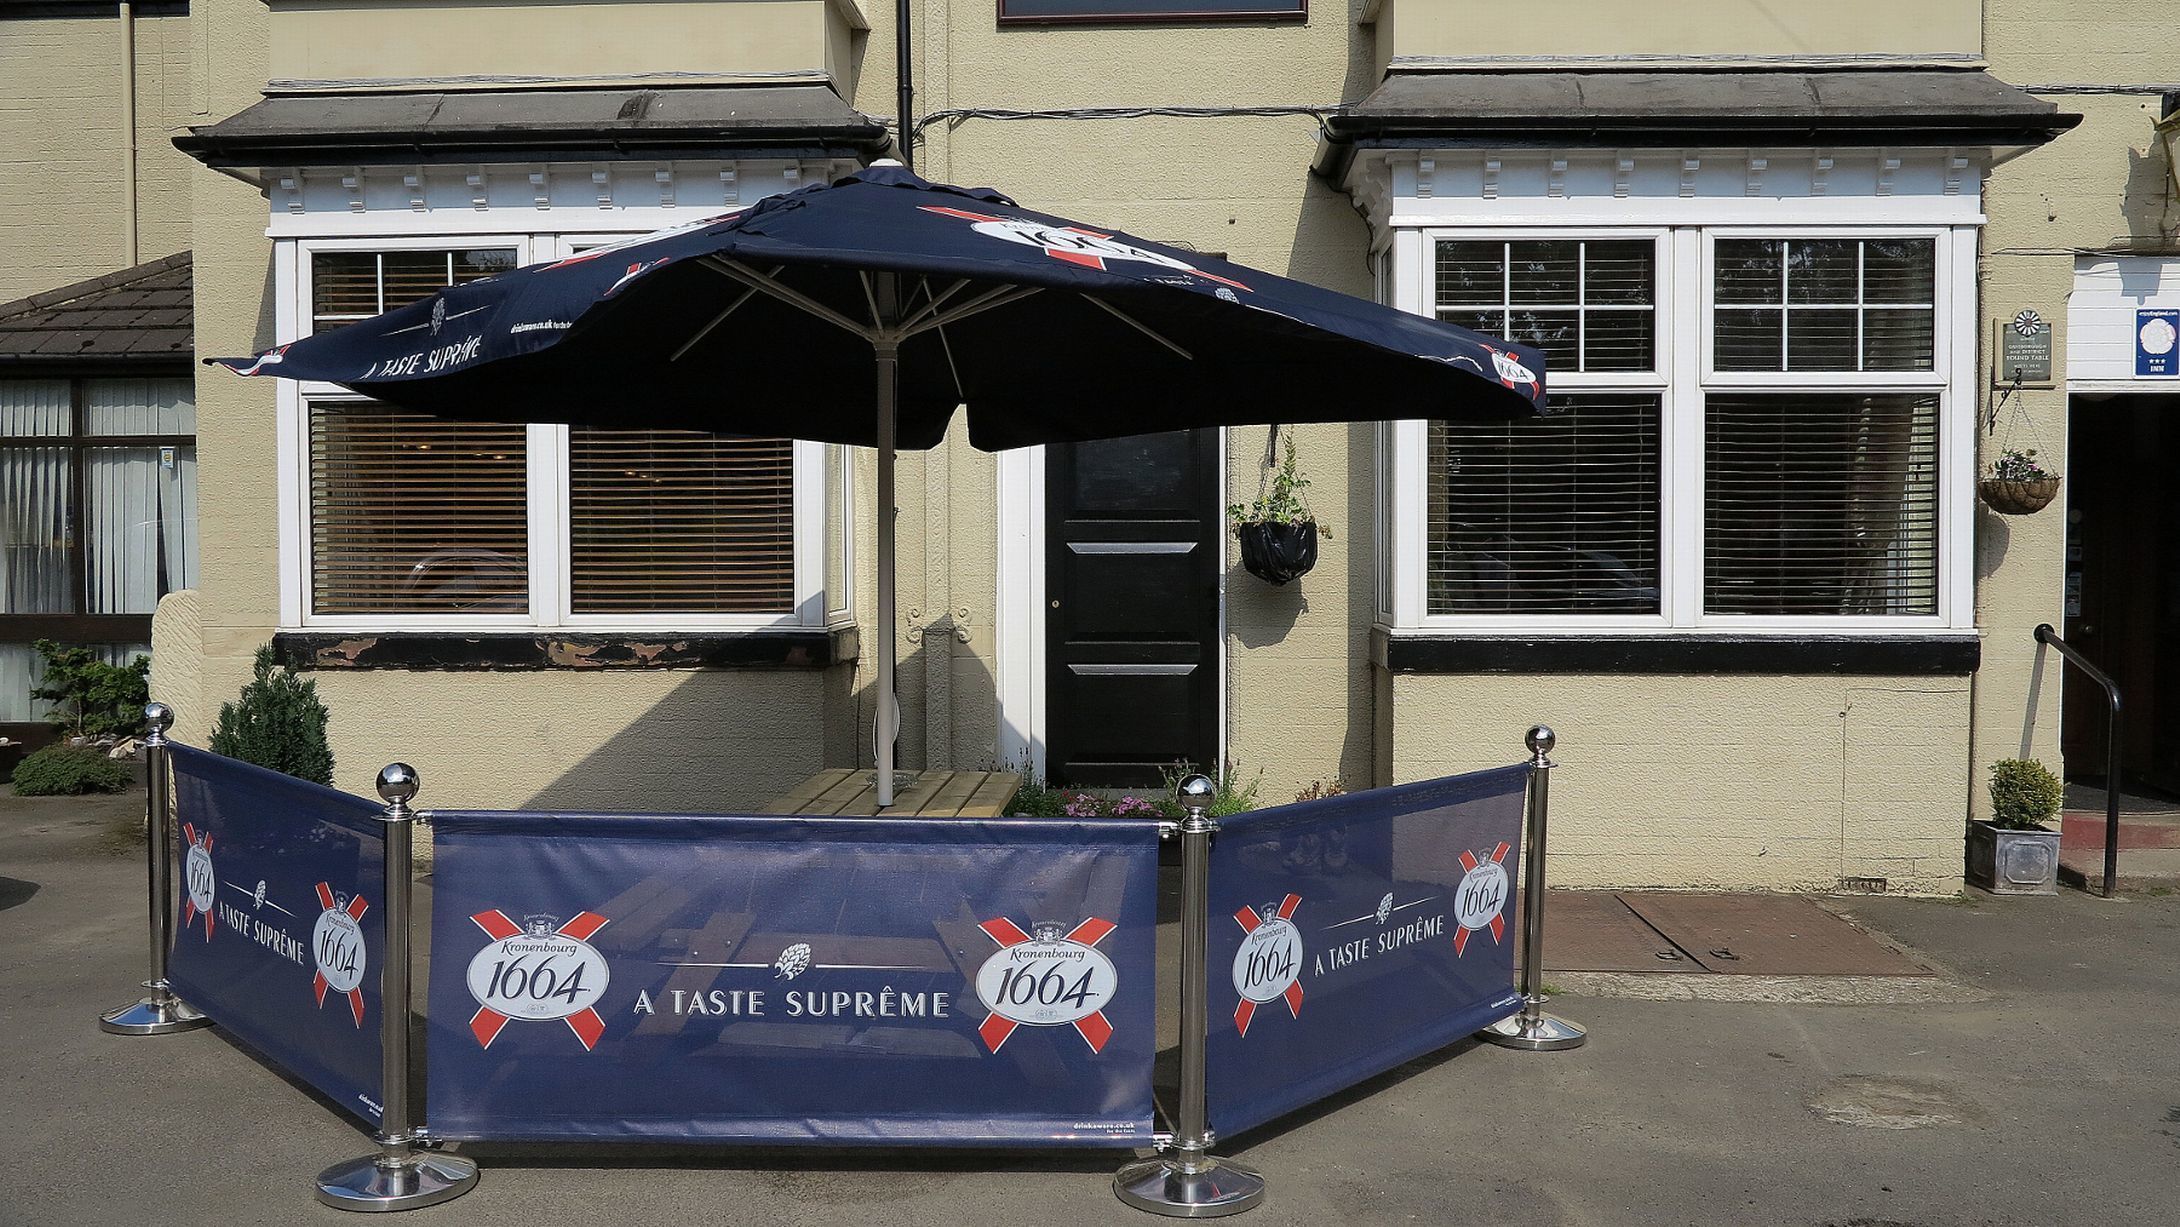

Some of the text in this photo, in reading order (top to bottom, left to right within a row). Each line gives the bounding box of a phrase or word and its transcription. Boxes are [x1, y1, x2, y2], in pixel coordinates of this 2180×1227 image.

[378, 352, 424, 378] TASTE
[189, 859, 213, 904] 1664
[1461, 876, 1502, 919] 1664
[219, 900, 305, 966] A TASTE SUPRÊME
[319, 926, 359, 981] 1664
[500, 940, 578, 958] Kronenbourg
[1009, 947, 1086, 963] Kronenbourg
[1314, 915, 1444, 978] A TASTE SUPRÊME
[486, 953, 591, 1005] 1664
[995, 960, 1099, 1010] 1664
[1243, 936, 1297, 991] 1664
[633, 985, 949, 1018] A TASTE SUPRÊME
